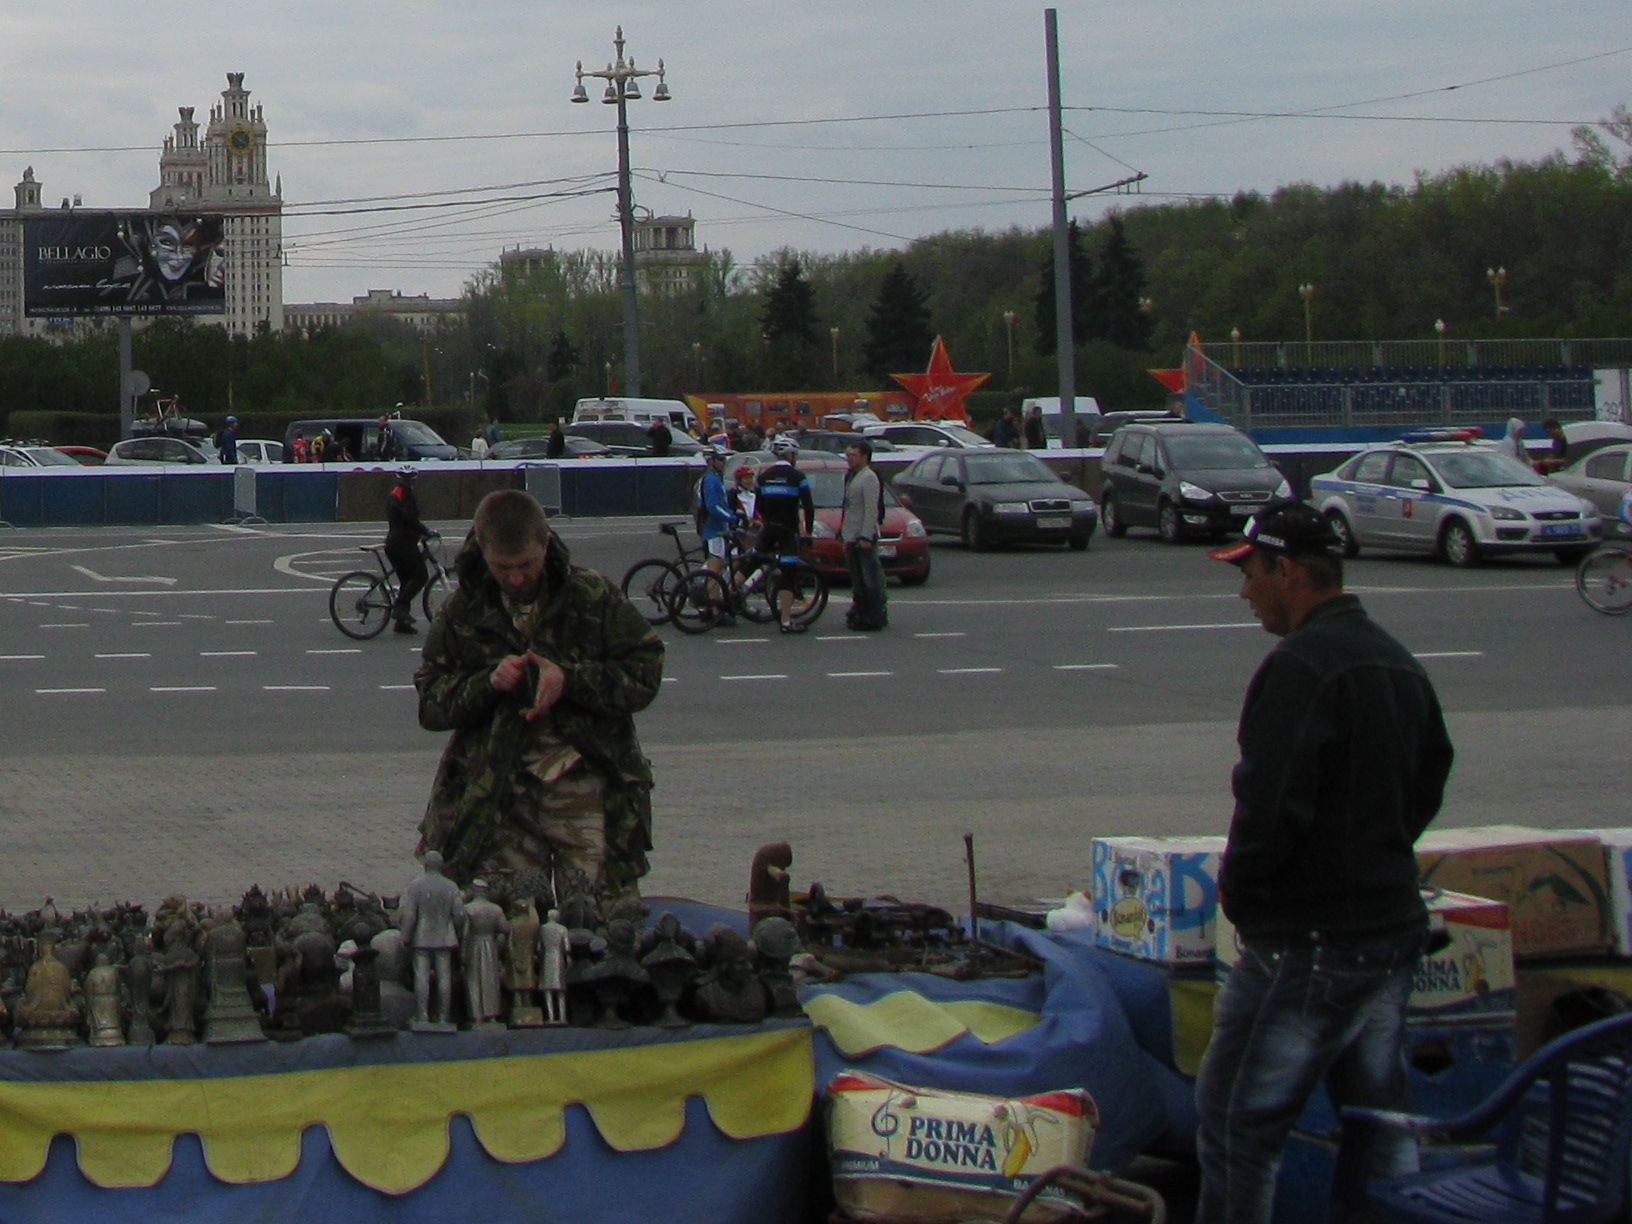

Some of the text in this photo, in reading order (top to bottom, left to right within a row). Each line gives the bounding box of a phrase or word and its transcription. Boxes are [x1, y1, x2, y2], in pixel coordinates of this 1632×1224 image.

[38, 245, 111, 260] BELLAGIO
[909, 1115, 997, 1148] PRIMA
[905, 1137, 998, 1172] DONNA
